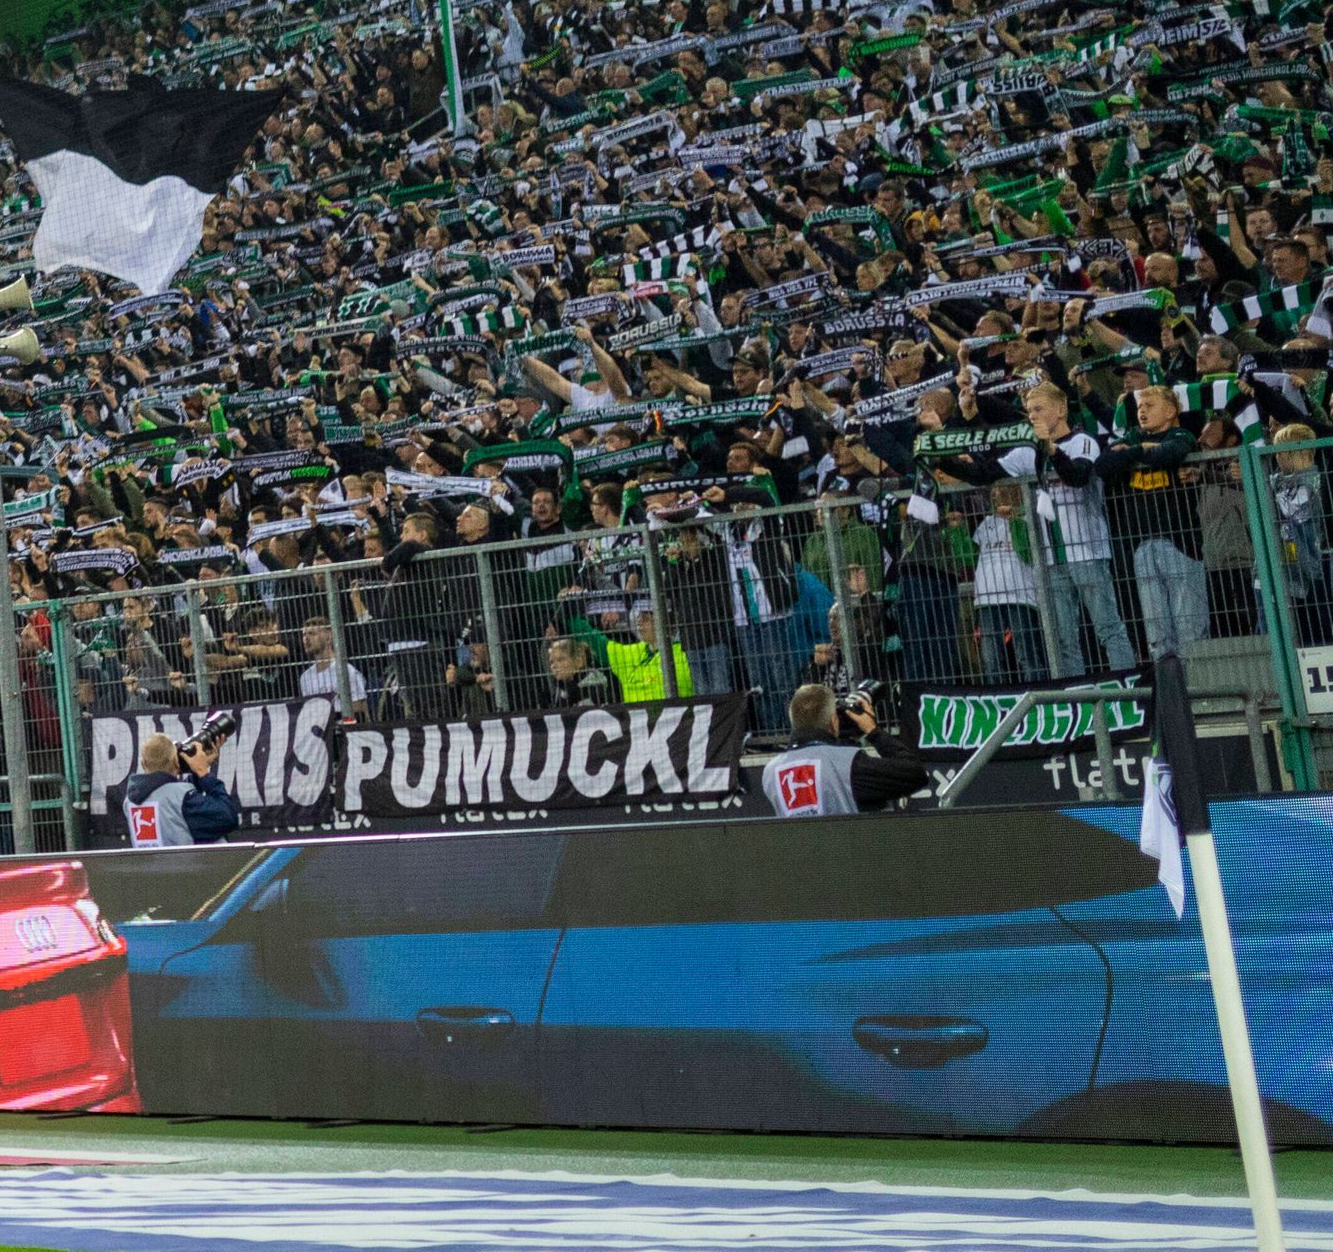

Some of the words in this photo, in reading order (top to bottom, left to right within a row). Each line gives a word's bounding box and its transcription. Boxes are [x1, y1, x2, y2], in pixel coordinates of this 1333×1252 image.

[609, 312, 682, 345] BORUSSIA
[824, 313, 905, 335] BORUSSIA
[934, 431, 985, 449] SEELE
[969, 443, 991, 453] 1900
[344, 704, 730, 812] PUMUCKL
